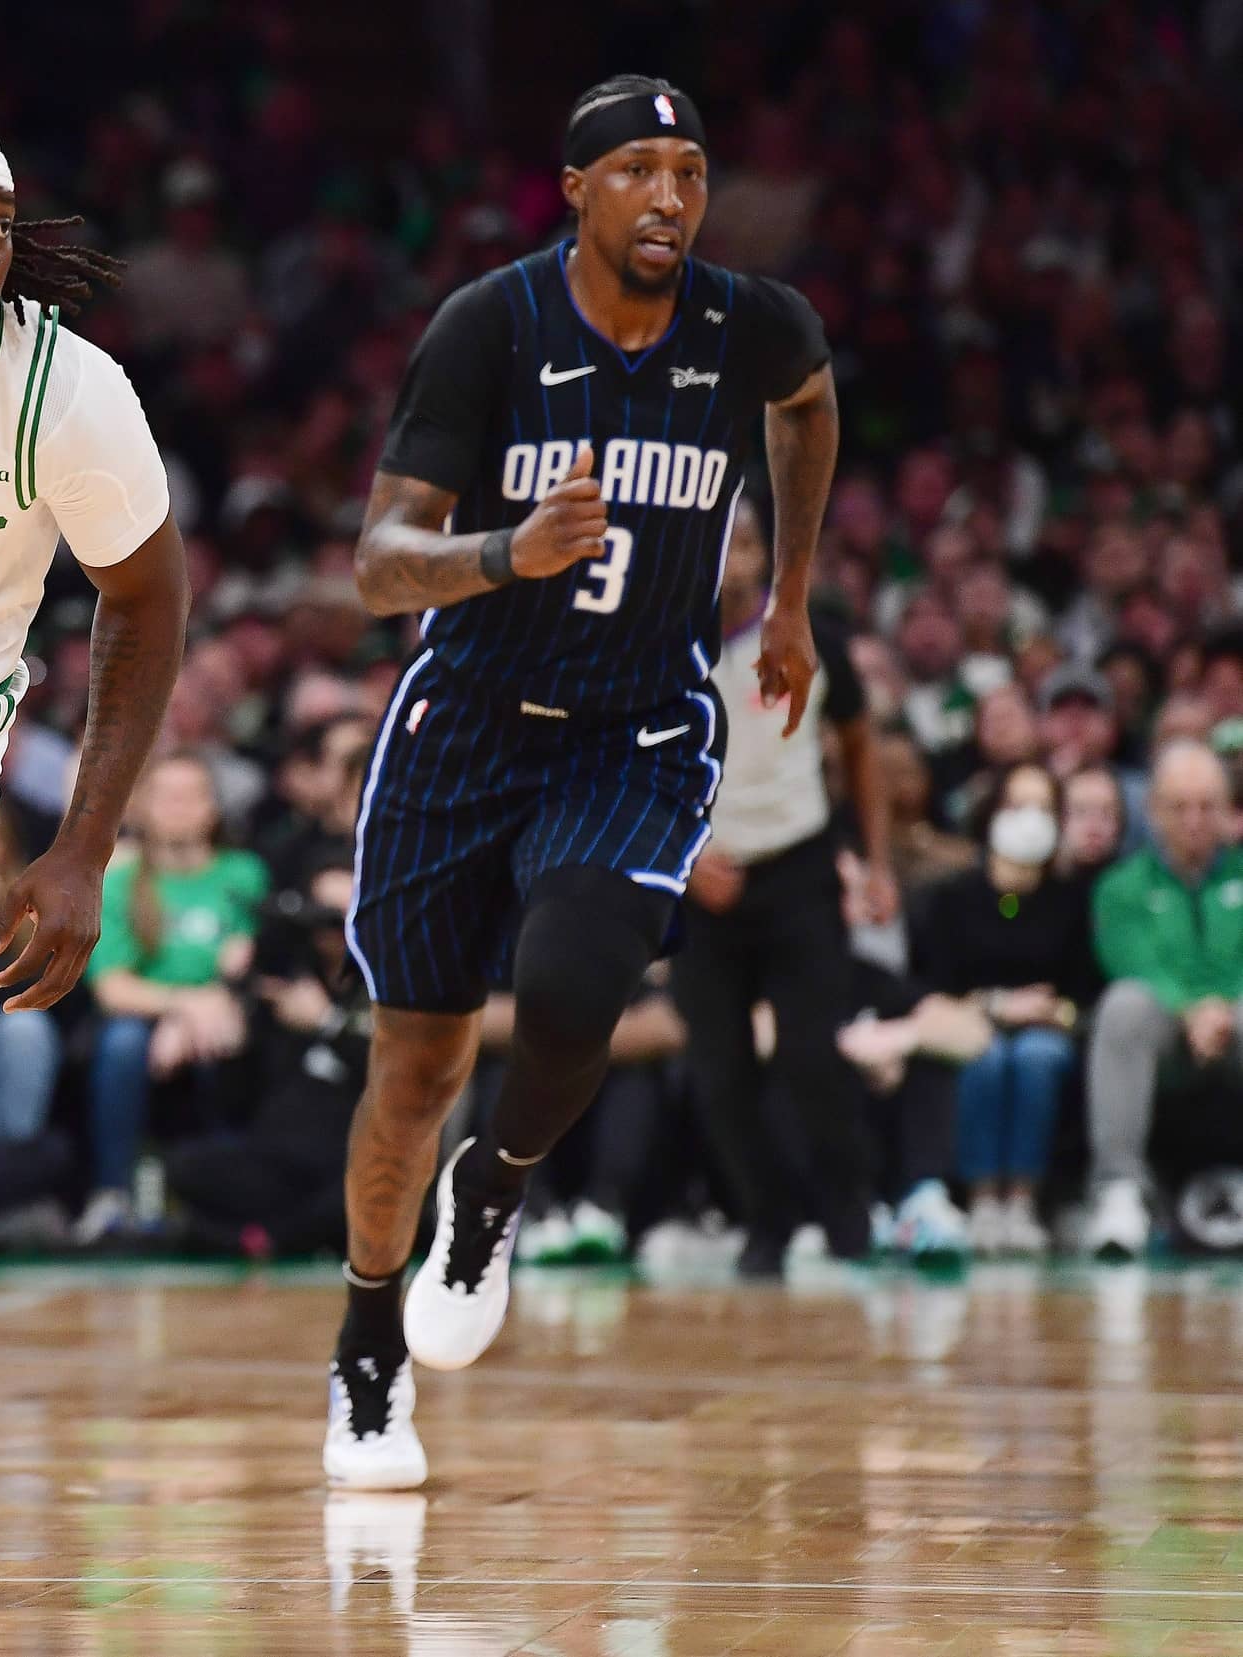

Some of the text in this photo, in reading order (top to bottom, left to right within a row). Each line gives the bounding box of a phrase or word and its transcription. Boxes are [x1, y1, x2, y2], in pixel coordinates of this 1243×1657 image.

[669, 366, 720, 389] Disney
[502, 438, 728, 511] ORANDO
[572, 525, 634, 614] 3
